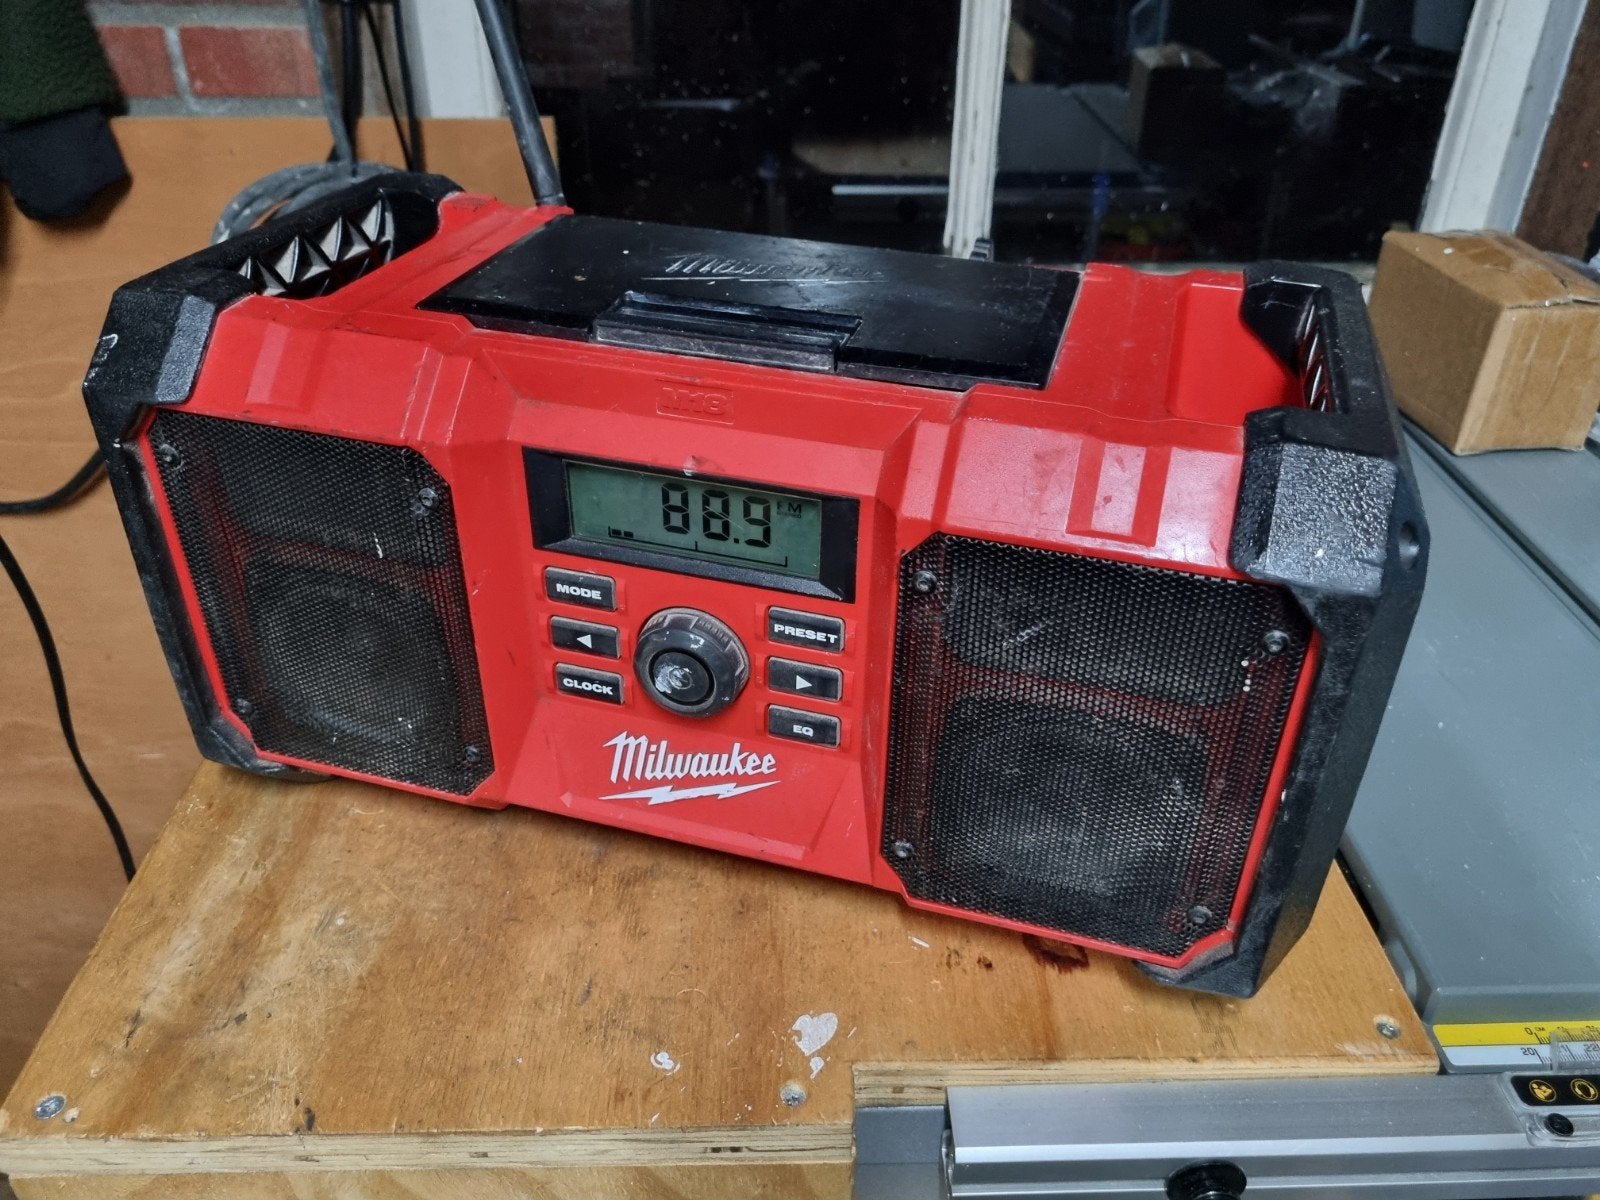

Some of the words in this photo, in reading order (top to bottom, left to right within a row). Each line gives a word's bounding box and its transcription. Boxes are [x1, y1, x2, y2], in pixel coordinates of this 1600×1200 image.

[661, 482, 771, 548] 88.9
[776, 501, 802, 514] FM
[556, 583, 602, 600] MODE
[774, 623, 838, 644] PRESET
[563, 677, 613, 696] CLOCK
[793, 724, 814, 737] EQ
[603, 730, 777, 784] Milwaukee
[1521, 1047, 1536, 1056] 20
